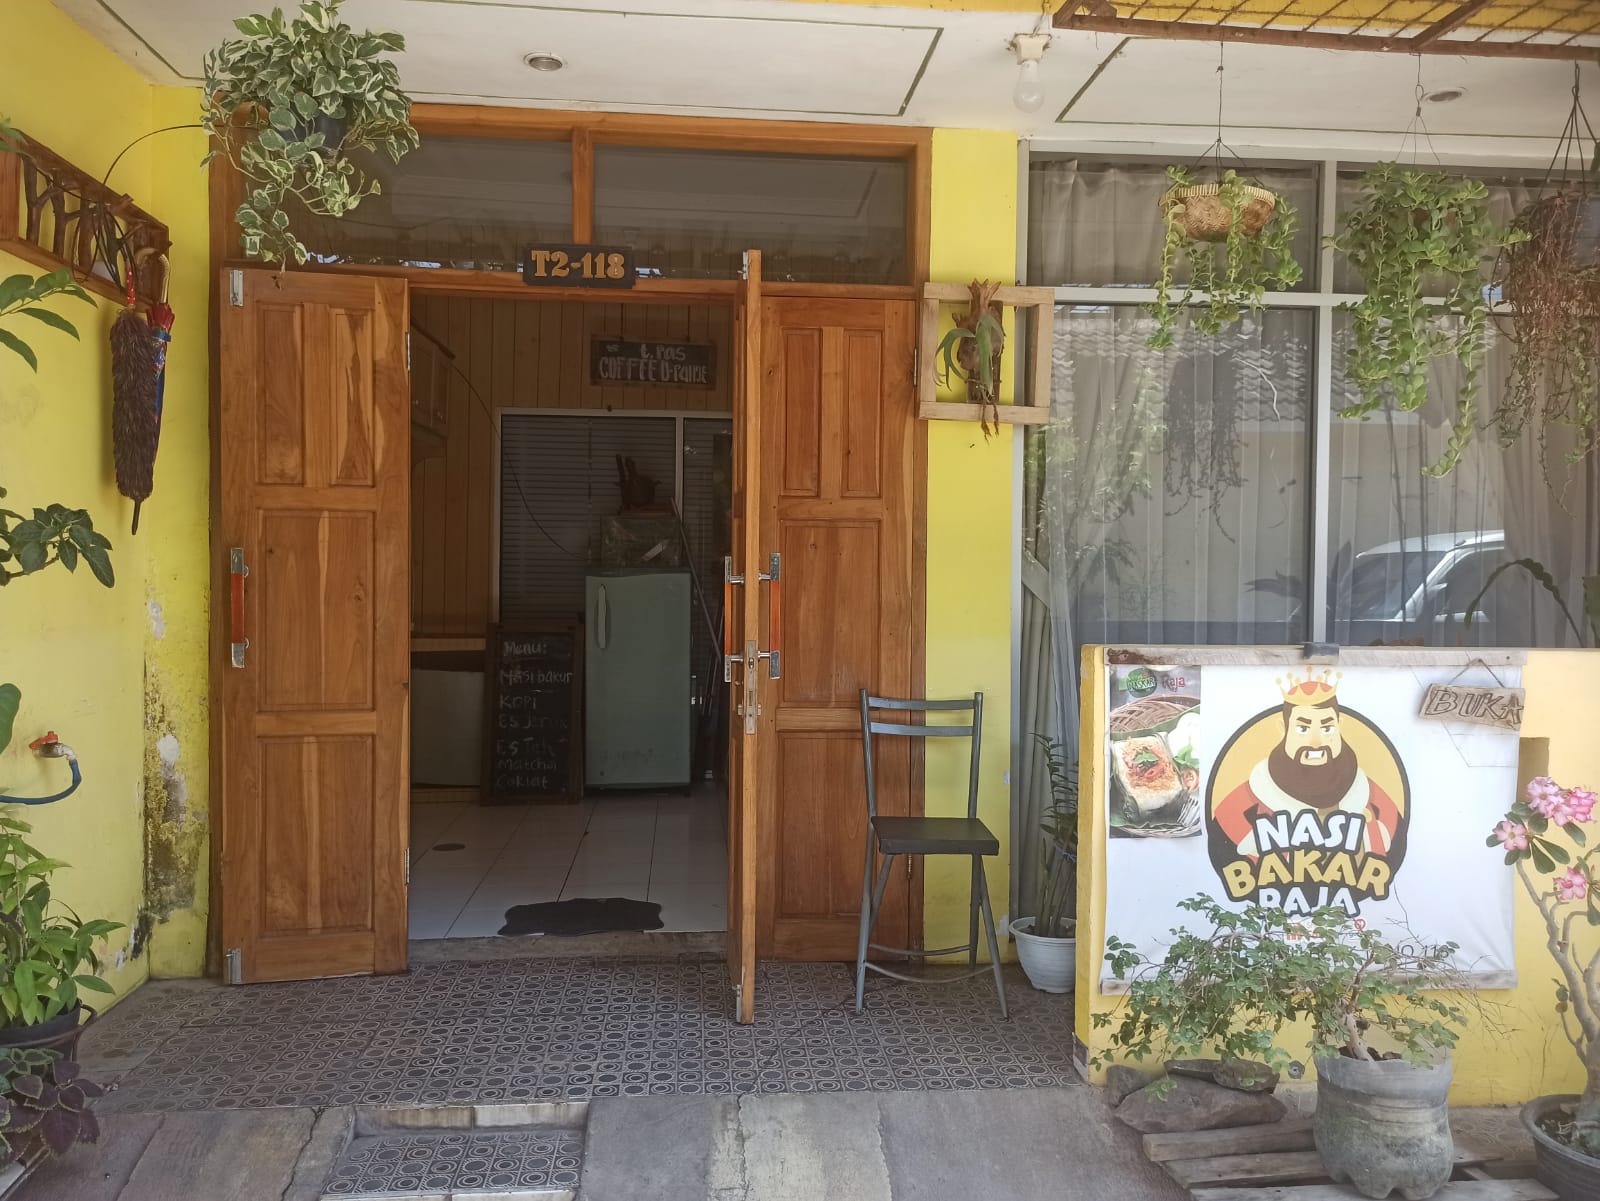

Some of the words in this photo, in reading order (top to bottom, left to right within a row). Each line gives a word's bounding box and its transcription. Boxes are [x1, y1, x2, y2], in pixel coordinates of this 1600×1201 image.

[531, 249, 625, 279] T2-118
[600, 357, 657, 381] COFFEE
[503, 641, 548, 656] Menu:
[1425, 689, 1524, 724] BUKA
[1255, 812, 1362, 852] NASI
[1222, 849, 1391, 898] BAKAR
